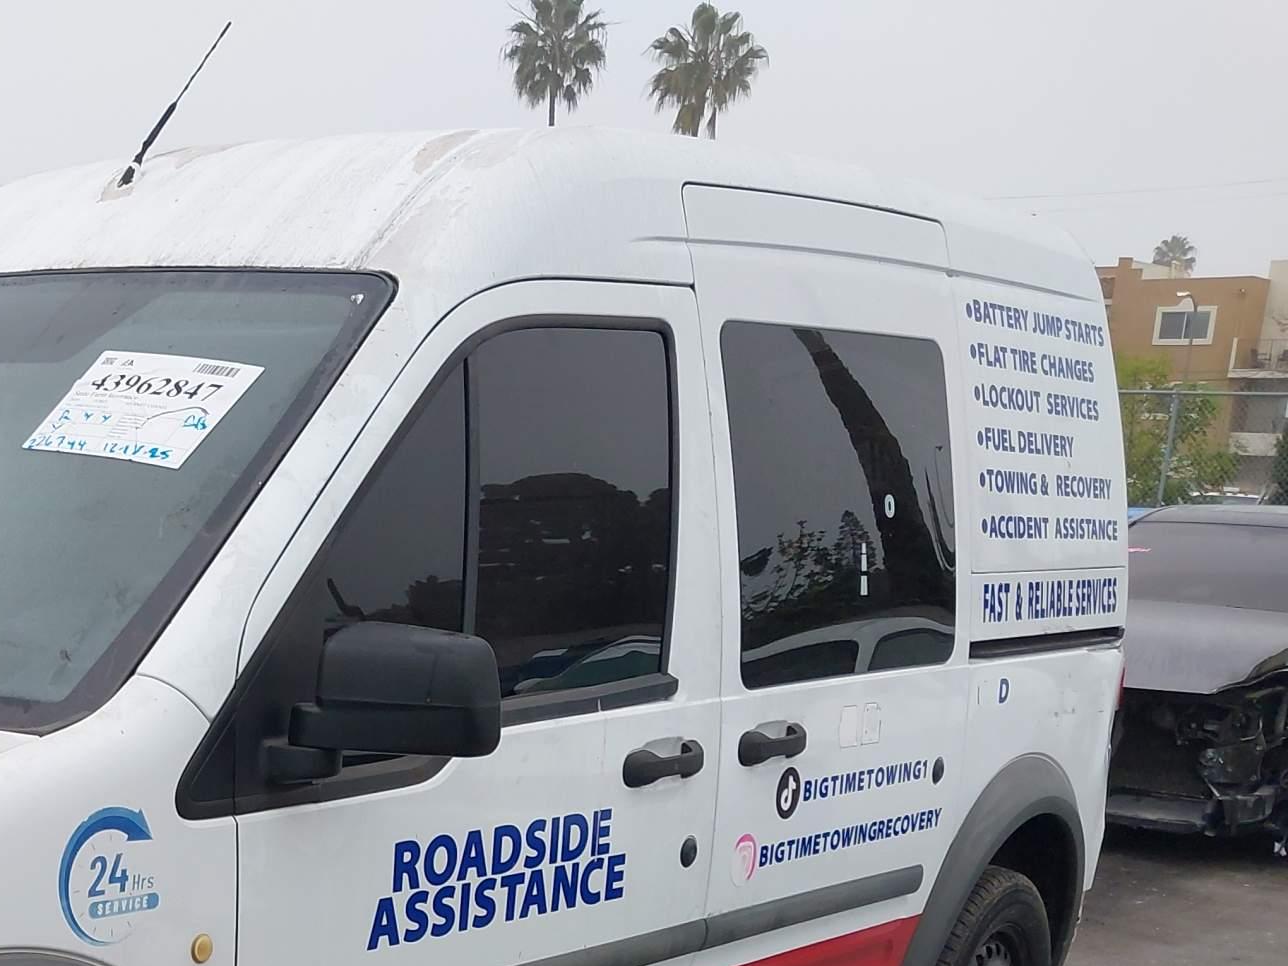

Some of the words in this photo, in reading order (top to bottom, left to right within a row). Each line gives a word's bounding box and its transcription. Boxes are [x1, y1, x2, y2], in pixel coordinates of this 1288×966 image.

[972, 299, 1028, 331] BATTERY
[1032, 312, 1062, 337] JUMP
[1065, 319, 1104, 347] STARTS
[977, 343, 1008, 369] FLAT
[1010, 348, 1037, 374] TIRE
[1041, 354, 1095, 383] CHANGES
[91, 374, 223, 401] 43962847
[982, 383, 1040, 413] LOCKOUT
[1047, 393, 1099, 421] SERVICES
[984, 427, 1015, 452] FUEL
[1018, 431, 1074, 457] DELIVERY
[986, 469, 1037, 495] TOWING
[1041, 474, 1049, 496] &
[1056, 474, 1111, 500] RECOVERY
[989, 515, 1049, 539] ACCIDENT
[1055, 517, 1118, 541] ASSISTANCE
[983, 583, 1010, 623] FAST
[1015, 582, 1023, 620] &
[1027, 580, 1073, 619] RELIABLE
[1075, 577, 1117, 616] SERVICES
[802, 758, 928, 802] BIGTIMETOWING1
[392, 808, 613, 893] ROADSIDE
[758, 807, 942, 868] BIGTIMETOWINGRECOVERY
[88, 853, 129, 898] 24
[132, 874, 154, 891] Hrs
[97, 896, 149, 915] SERVICE
[367, 853, 626, 951] ASSISTANCE
